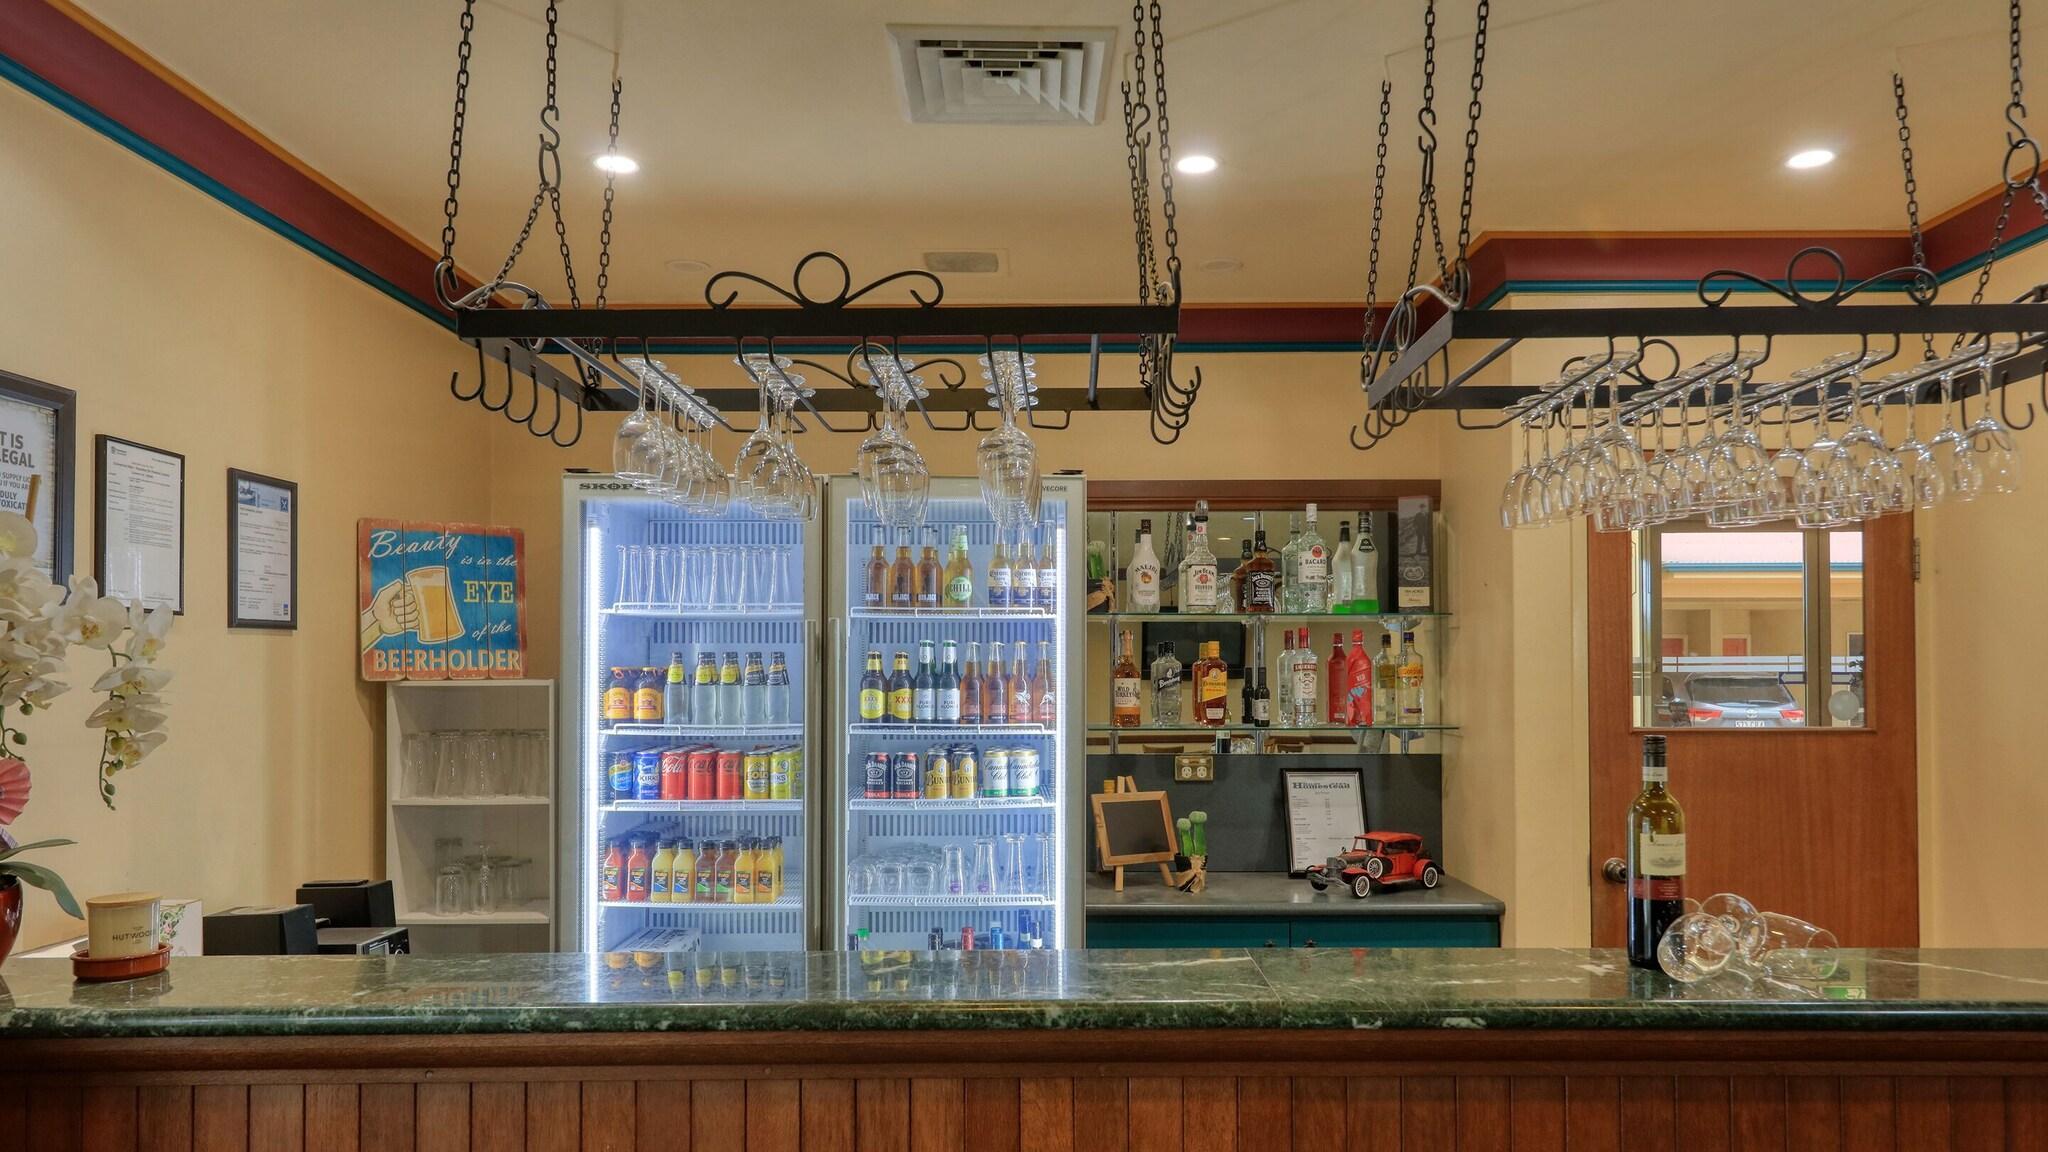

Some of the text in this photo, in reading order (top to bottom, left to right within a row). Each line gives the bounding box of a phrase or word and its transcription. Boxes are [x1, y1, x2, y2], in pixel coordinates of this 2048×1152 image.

[10, 433, 24, 449] IS
[0, 447, 35, 468] EGAL
[2, 471, 21, 481] SUPPLY
[368, 531, 462, 560] Beauty
[460, 554, 518, 567] is in the
[463, 580, 514, 604] EYE
[471, 619, 512, 641] of the
[374, 649, 521, 673] BEERHOLDER
